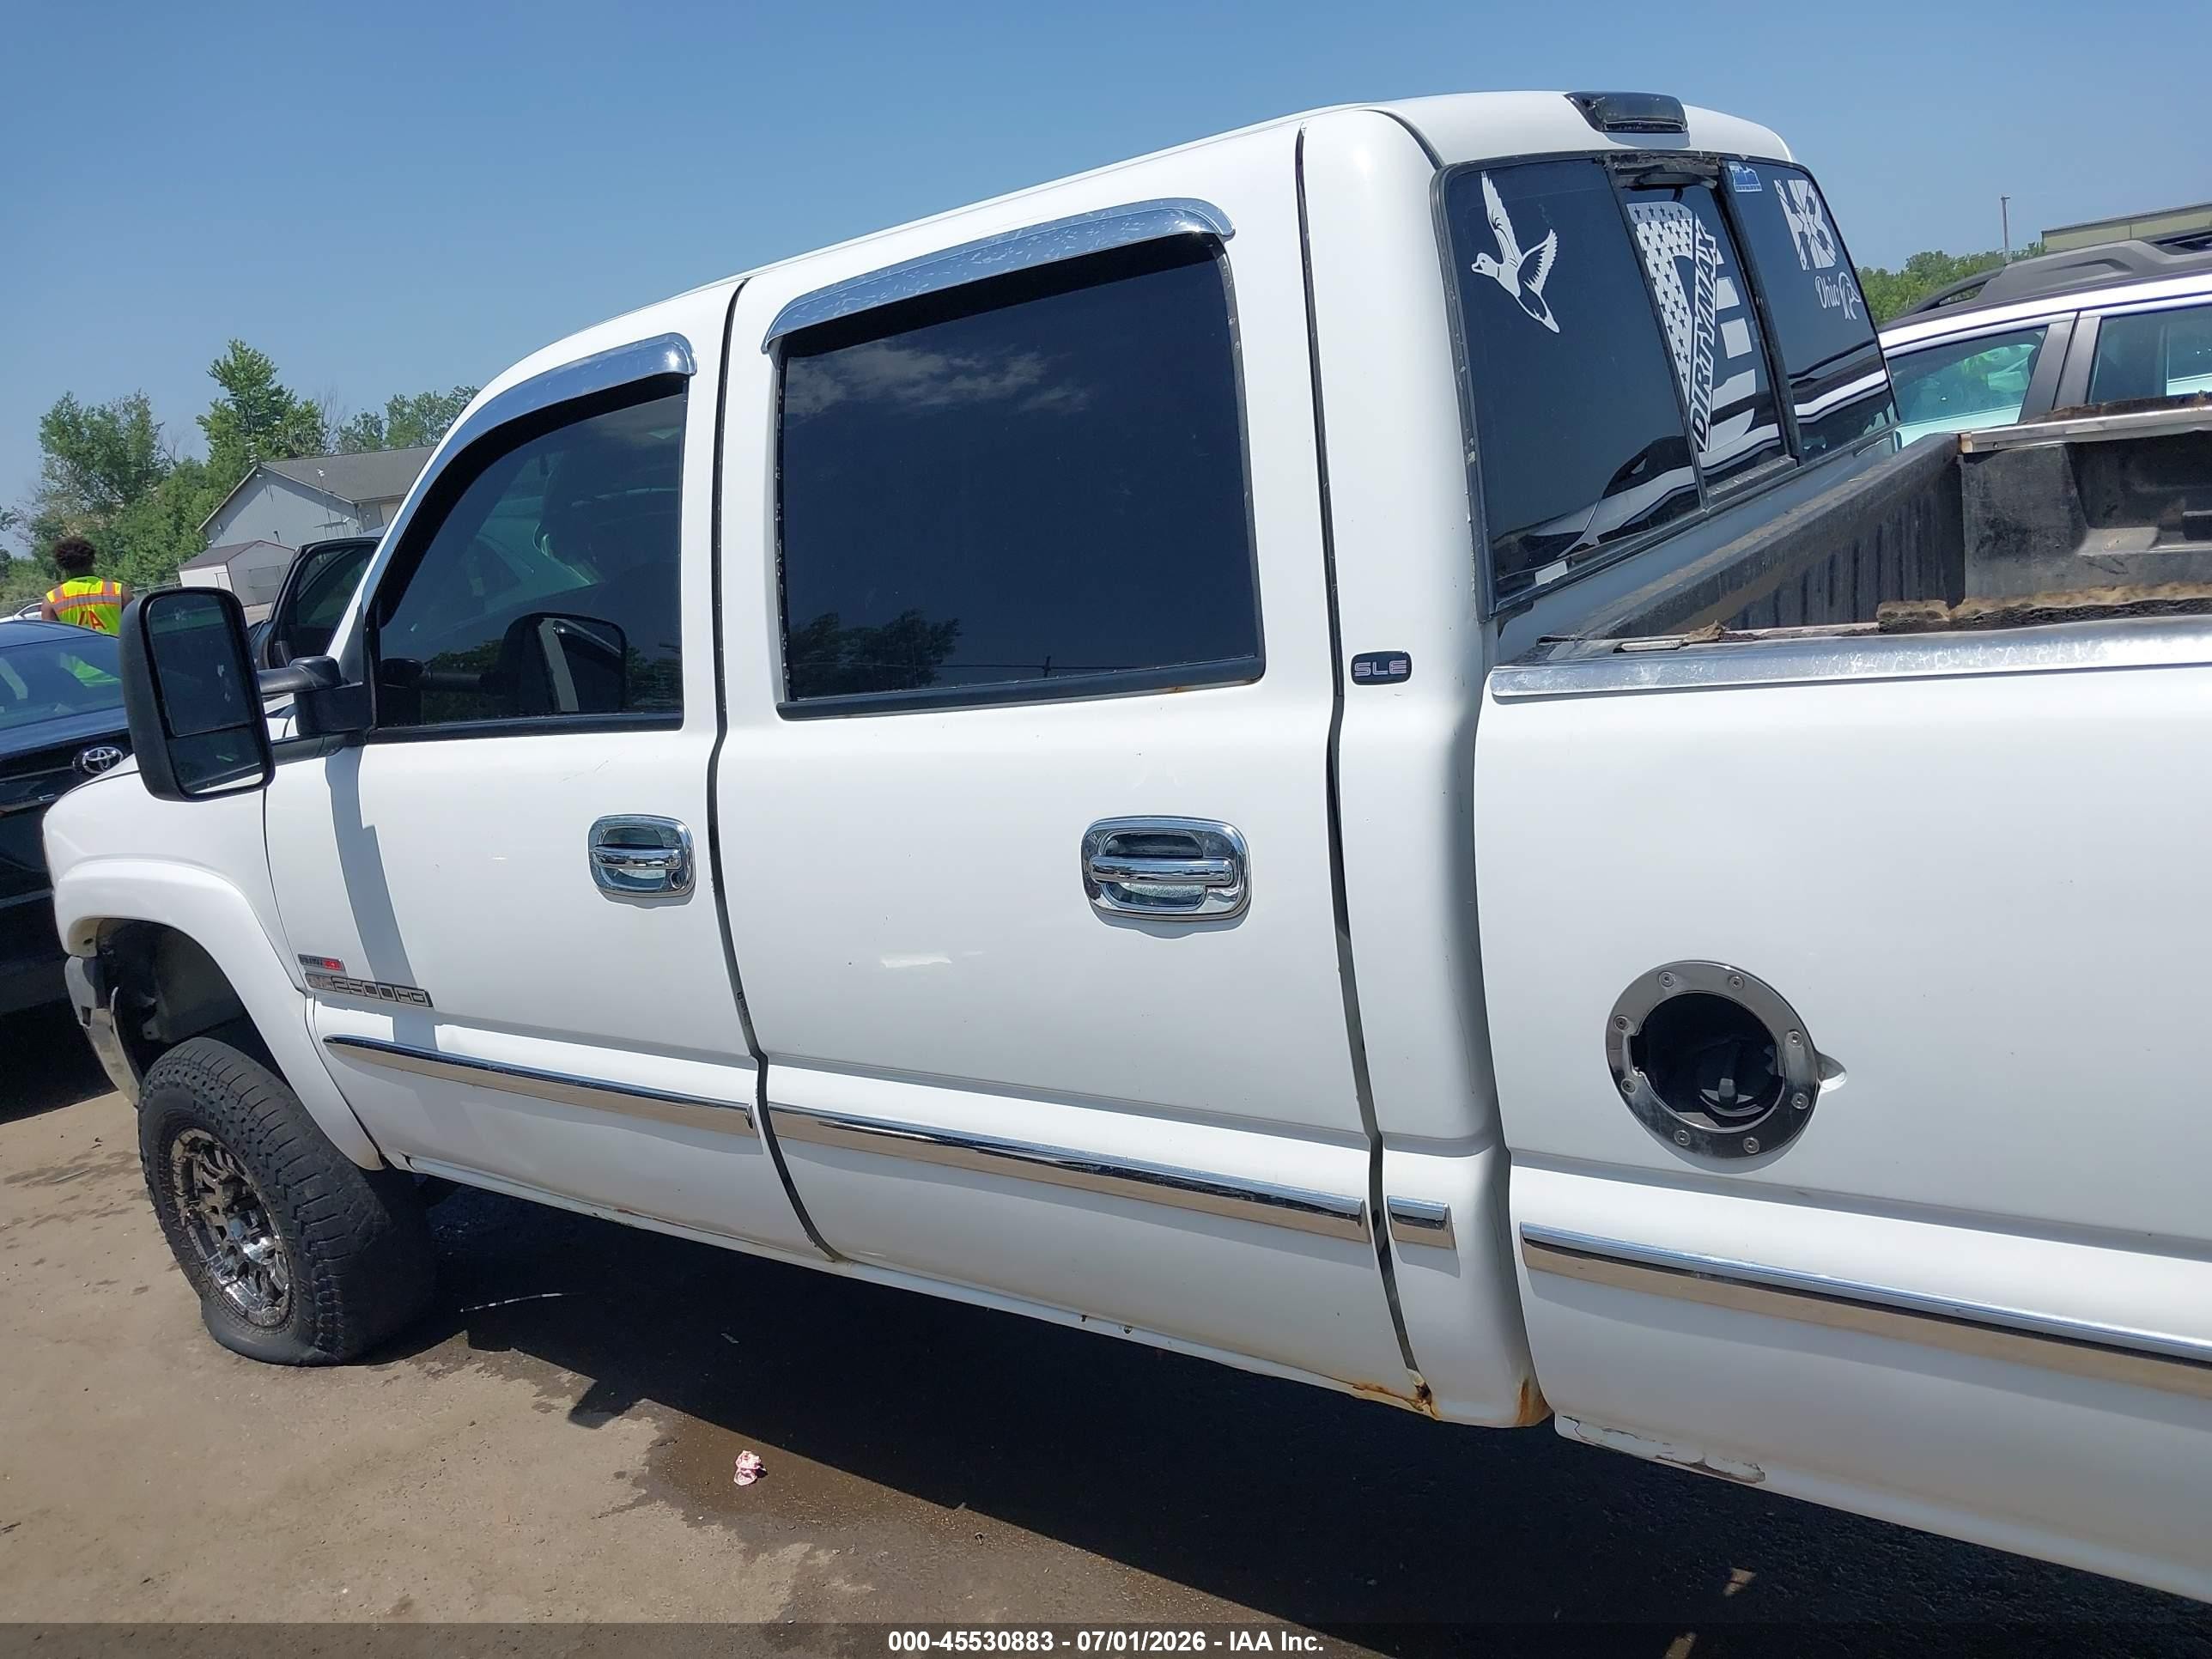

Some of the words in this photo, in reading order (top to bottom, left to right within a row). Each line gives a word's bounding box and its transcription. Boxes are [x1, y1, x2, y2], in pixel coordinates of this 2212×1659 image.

[1814, 276, 1841, 309] Ohio
[1690, 213, 1717, 453] DIRTYMAX
[1354, 659, 1407, 677] SLE
